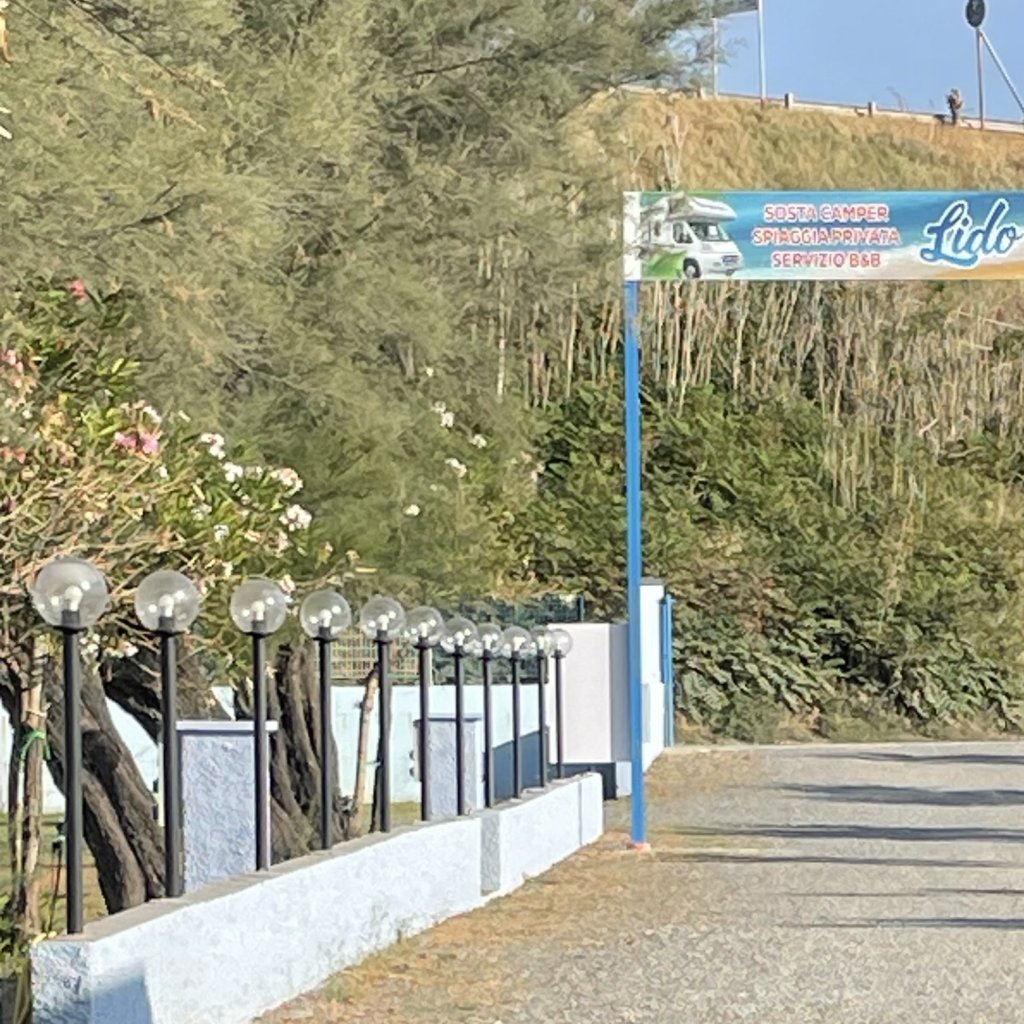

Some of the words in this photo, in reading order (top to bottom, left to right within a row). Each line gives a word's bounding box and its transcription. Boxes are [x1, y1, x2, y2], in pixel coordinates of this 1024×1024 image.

[764, 204, 816, 221] SOSTA
[819, 204, 889, 221] CAMPER
[752, 228, 831, 245] SPIAGGIA
[832, 228, 900, 245] PRIVATA
[920, 199, 1023, 268] Lido
[772, 253, 845, 268] SERVIZIO
[849, 253, 881, 268] B&B
